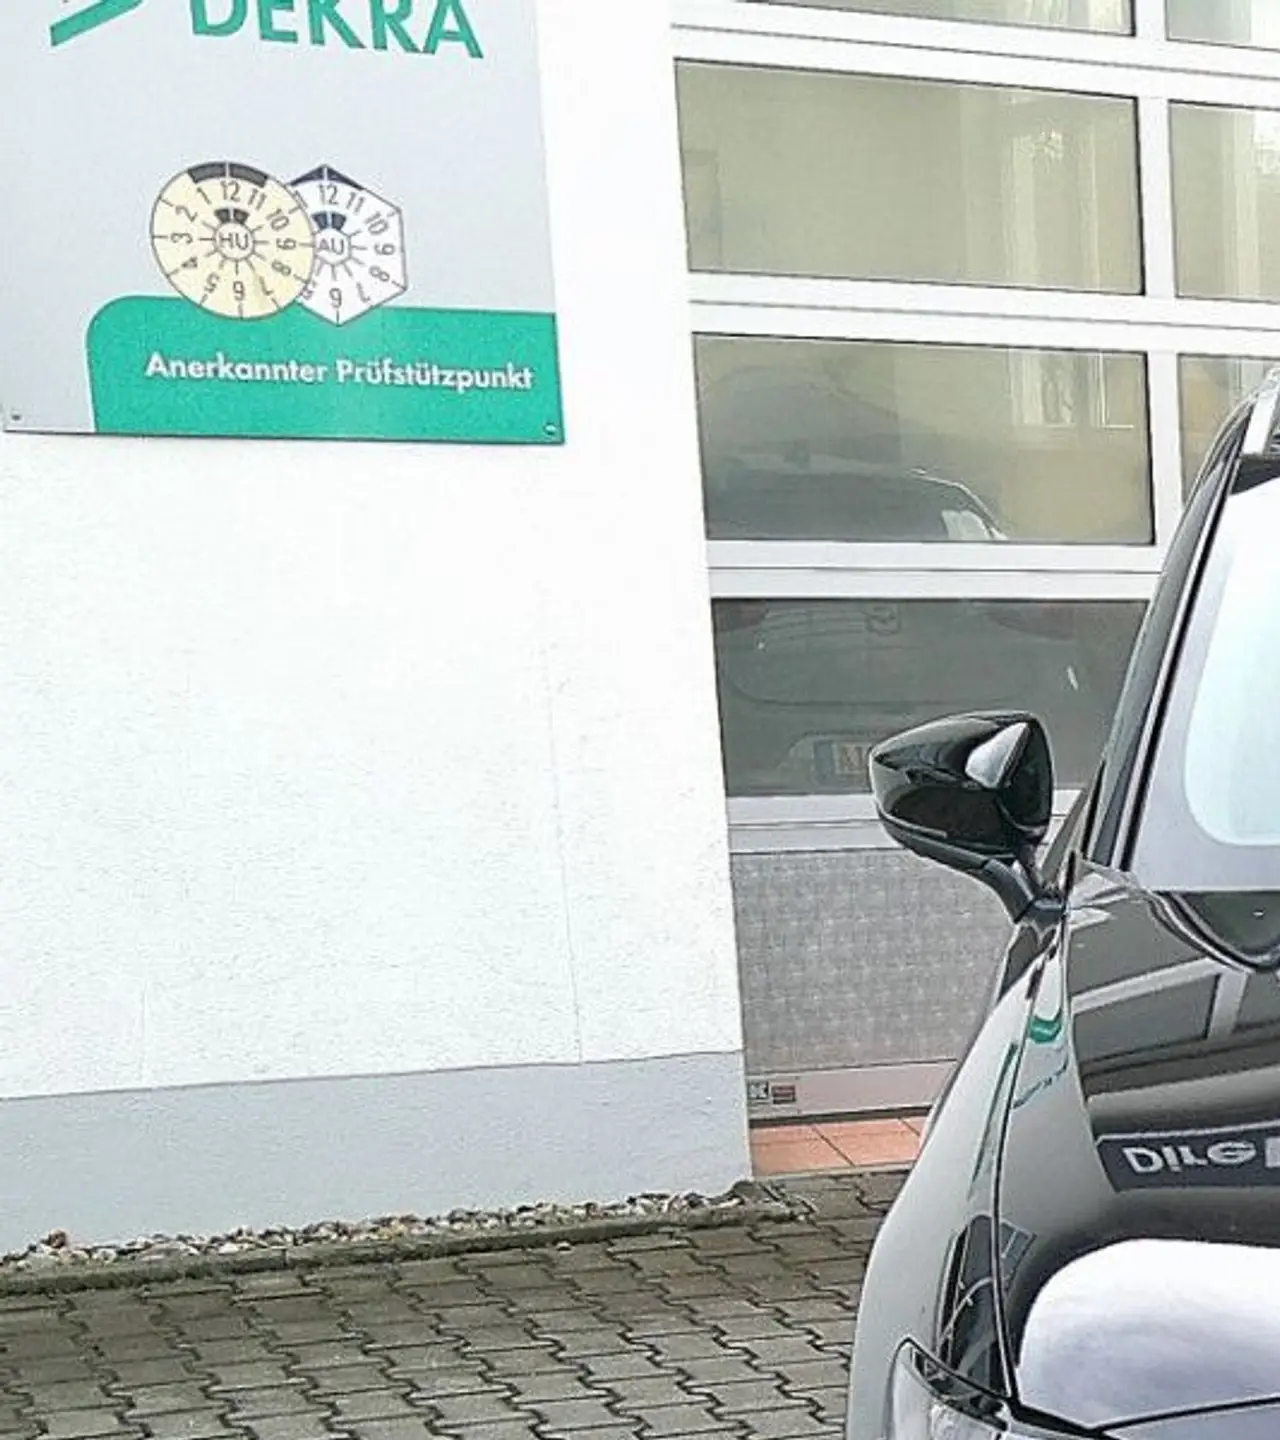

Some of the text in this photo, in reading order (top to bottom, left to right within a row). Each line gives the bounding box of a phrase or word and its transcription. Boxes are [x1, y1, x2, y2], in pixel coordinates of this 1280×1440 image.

[190, 0, 484, 59] DEKRA
[221, 181, 241, 201] 12
[319, 184, 339, 205] 12
[219, 232, 249, 250] HU
[145, 352, 533, 393] Anerkannter Prüfstützpunkt
